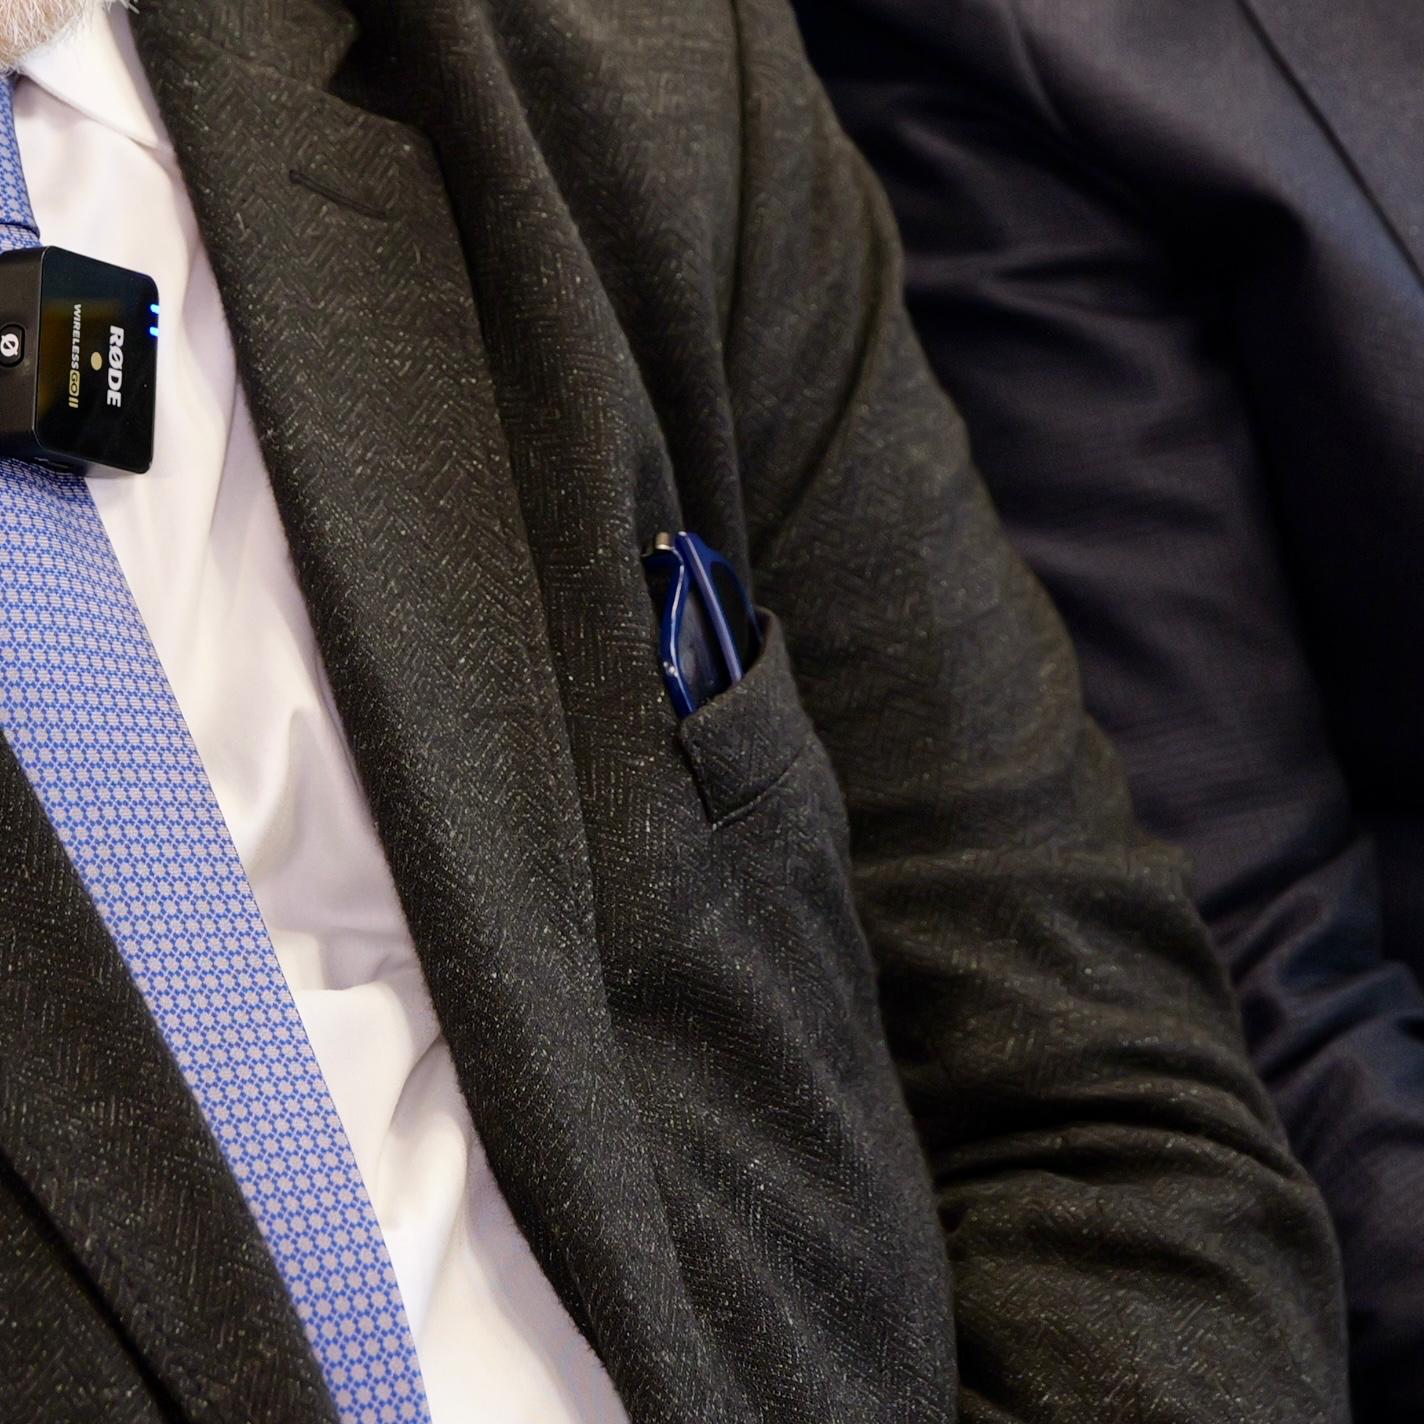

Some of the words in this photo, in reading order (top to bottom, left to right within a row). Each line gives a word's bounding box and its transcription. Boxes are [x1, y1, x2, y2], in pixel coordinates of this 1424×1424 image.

[71, 304, 82, 370] WIRELESS
[107, 325, 125, 407] RØDE
[69, 371, 80, 396] GO
